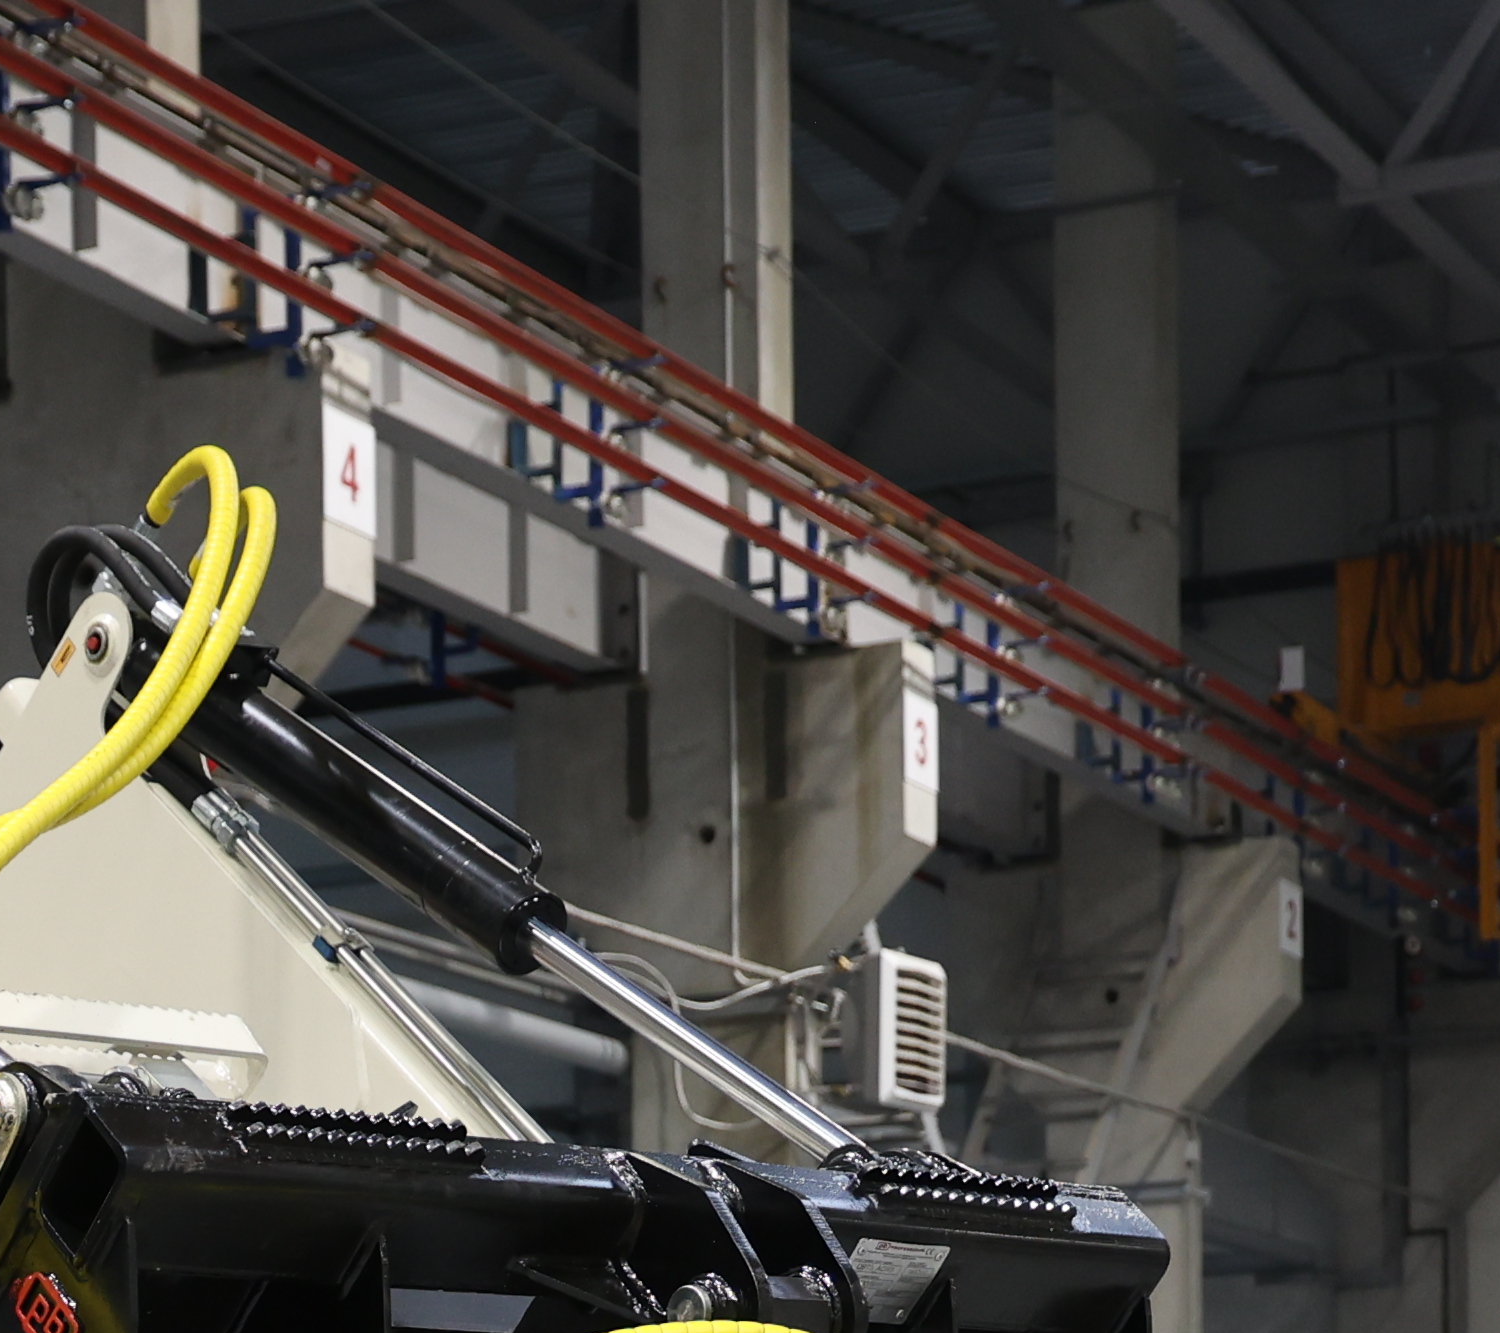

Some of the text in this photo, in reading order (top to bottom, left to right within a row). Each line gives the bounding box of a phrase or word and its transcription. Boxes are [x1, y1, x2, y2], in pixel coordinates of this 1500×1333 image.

[340, 445, 360, 503] 4
[915, 717, 929, 767] 3
[1285, 900, 1299, 941] 2
